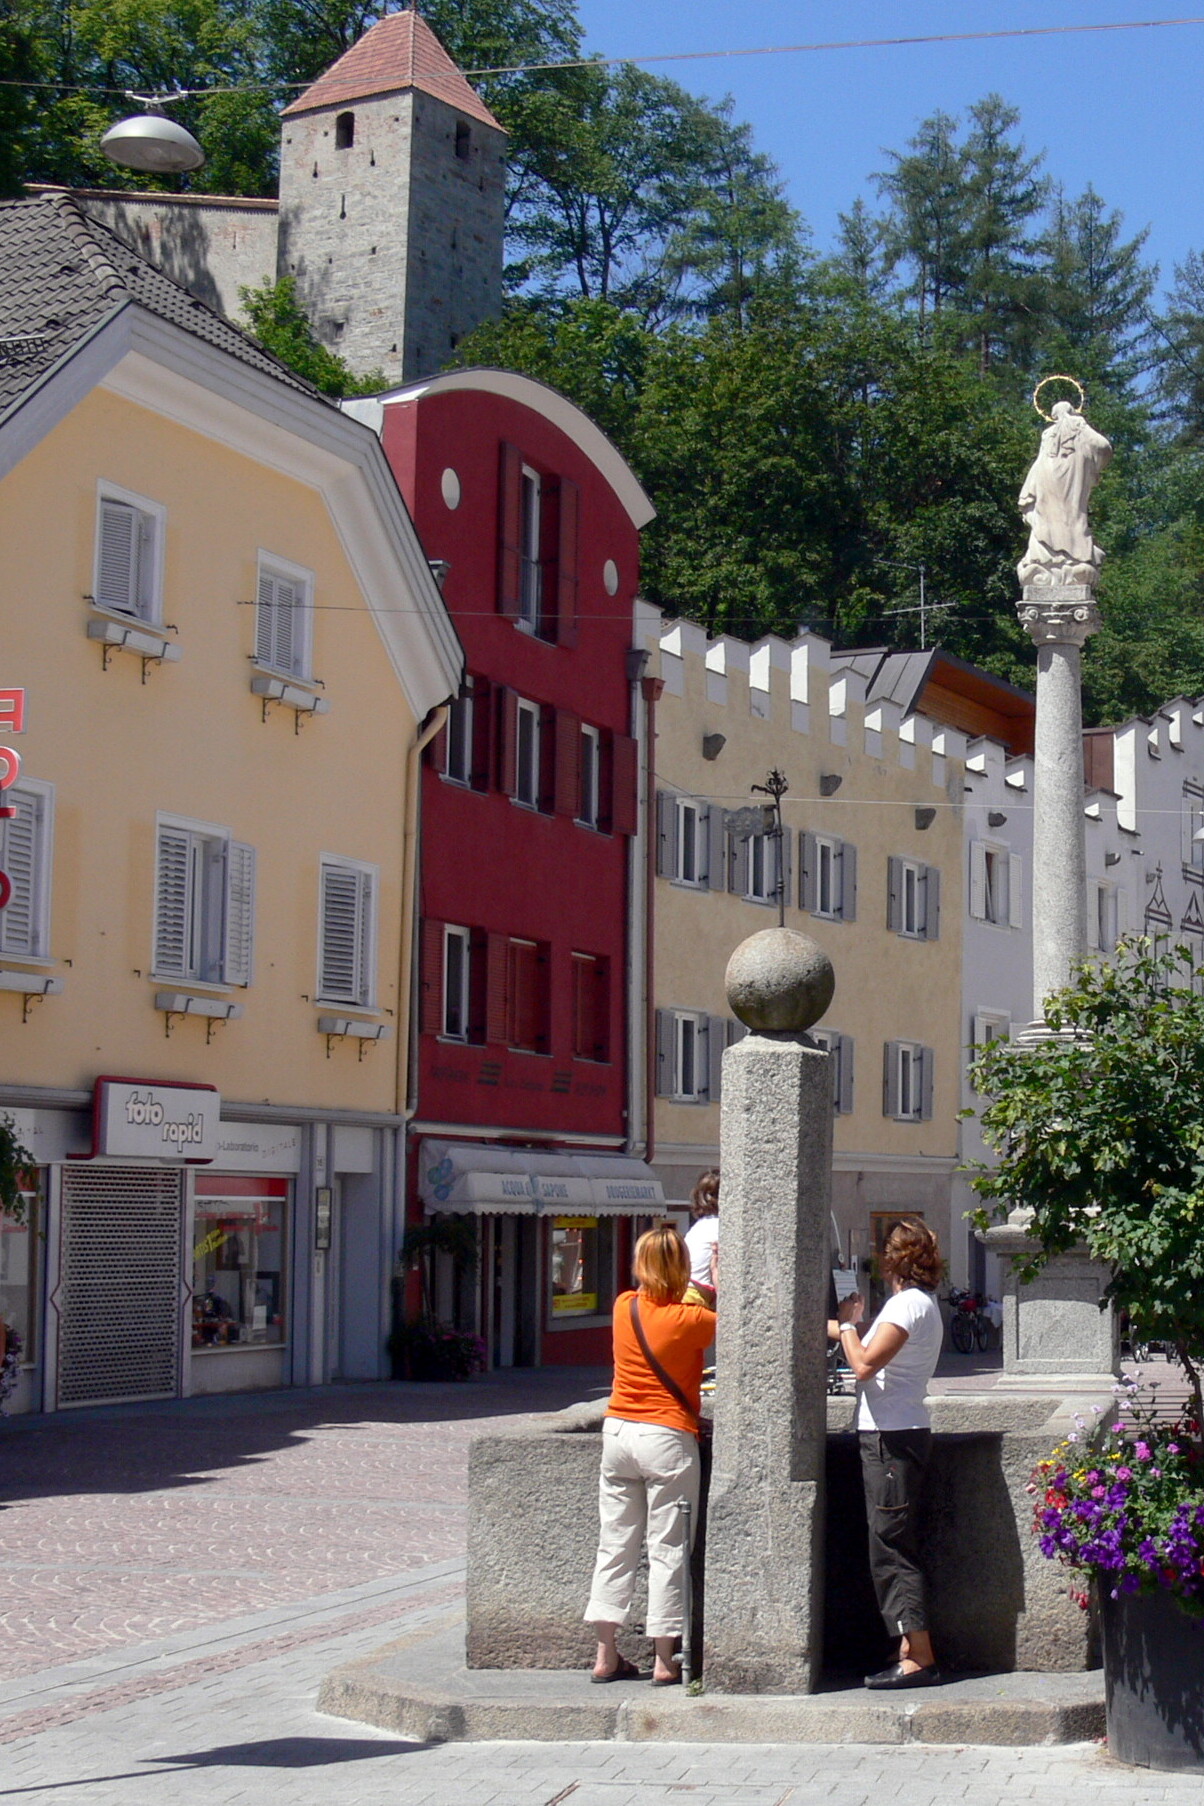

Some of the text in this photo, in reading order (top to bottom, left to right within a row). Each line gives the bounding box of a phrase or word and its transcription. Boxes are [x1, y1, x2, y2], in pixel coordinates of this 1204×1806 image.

[125, 1091, 165, 1127] foto
[162, 1112, 205, 1154] rapid
[501, 1180, 525, 1196] ACQUA
[542, 1183, 569, 1199] SAPONE
[605, 1184, 657, 1201] DROGERIEMARKT
